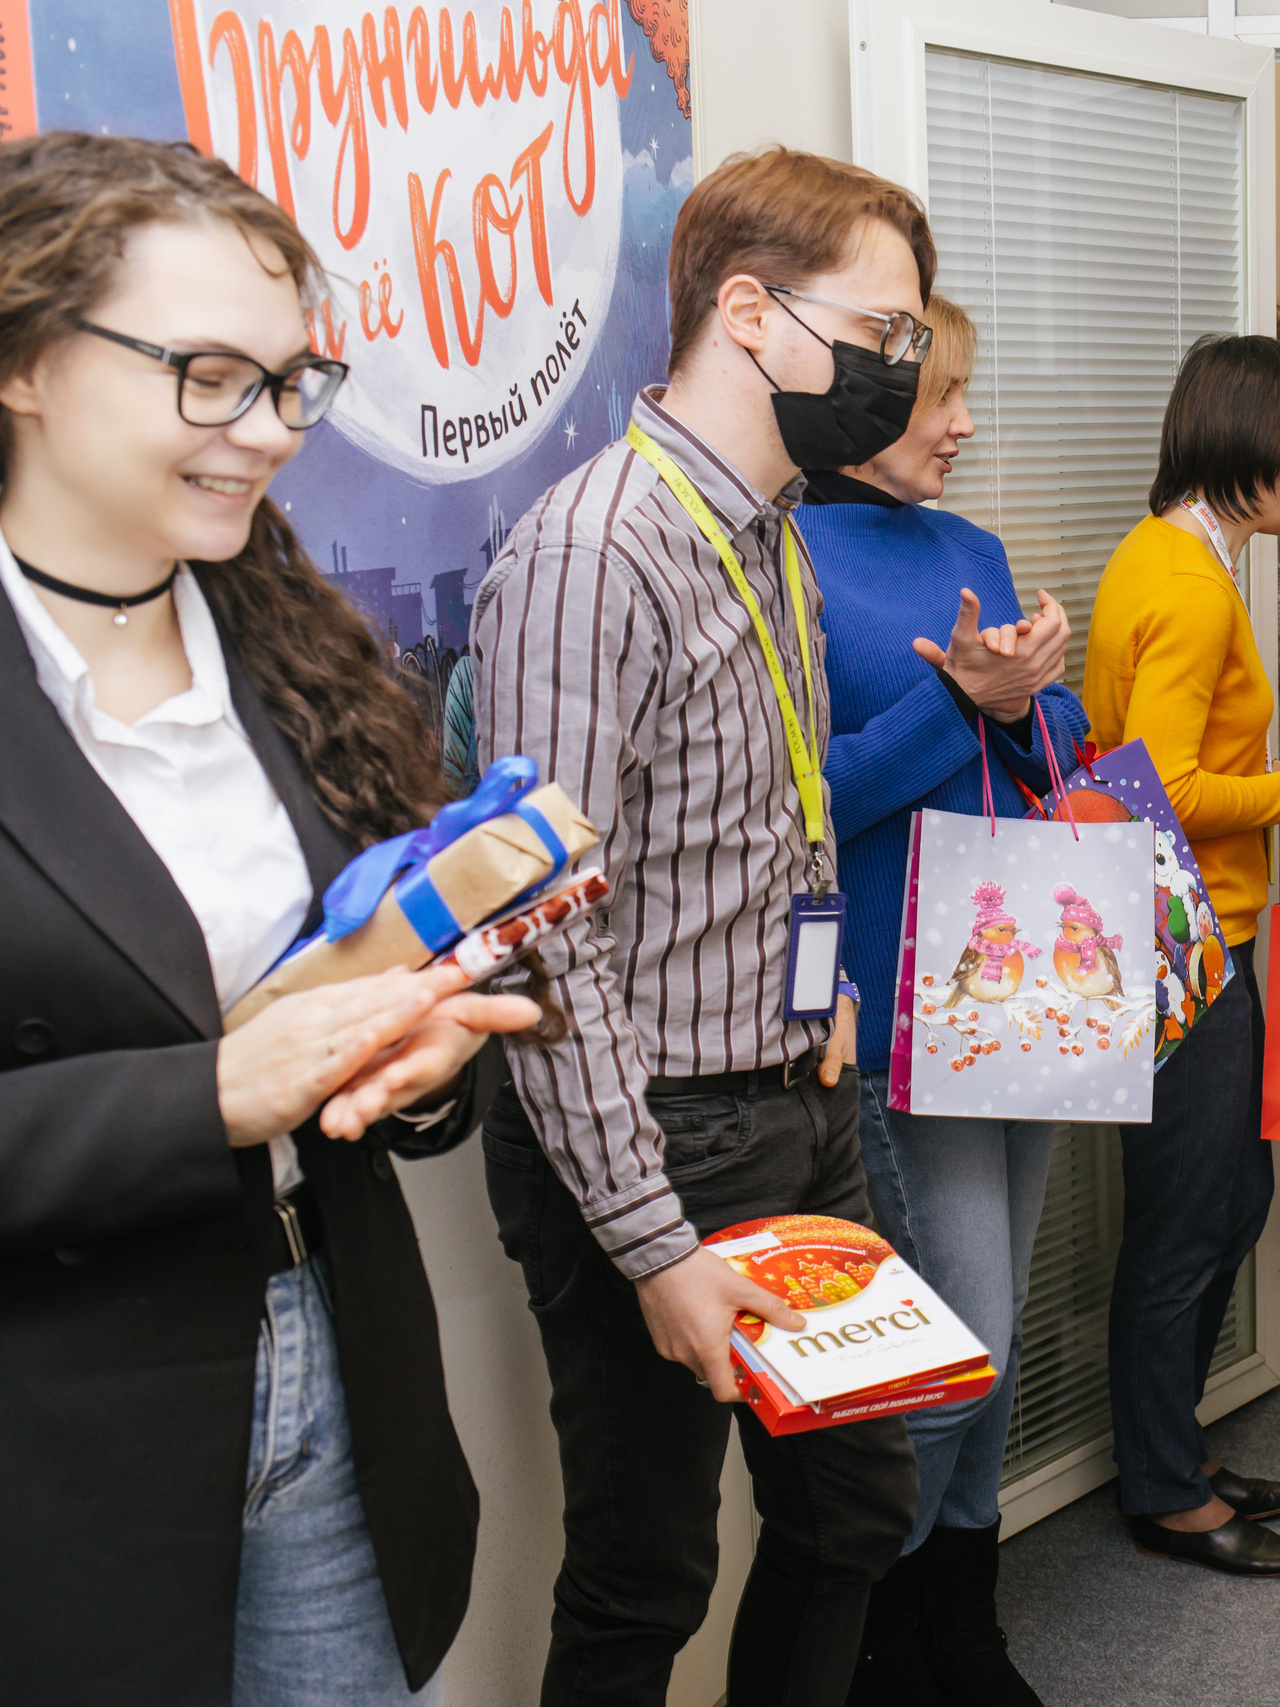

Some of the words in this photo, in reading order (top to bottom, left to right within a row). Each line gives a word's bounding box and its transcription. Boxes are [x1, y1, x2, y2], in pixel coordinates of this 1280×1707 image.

[359, 257, 404, 342] её
[420, 383, 529, 464] Первый
[530, 298, 589, 407] полёт
[787, 1299, 932, 1358] merci
[869, 1401, 889, 1412] СВОЙ
[887, 1377, 911, 1390] merci
